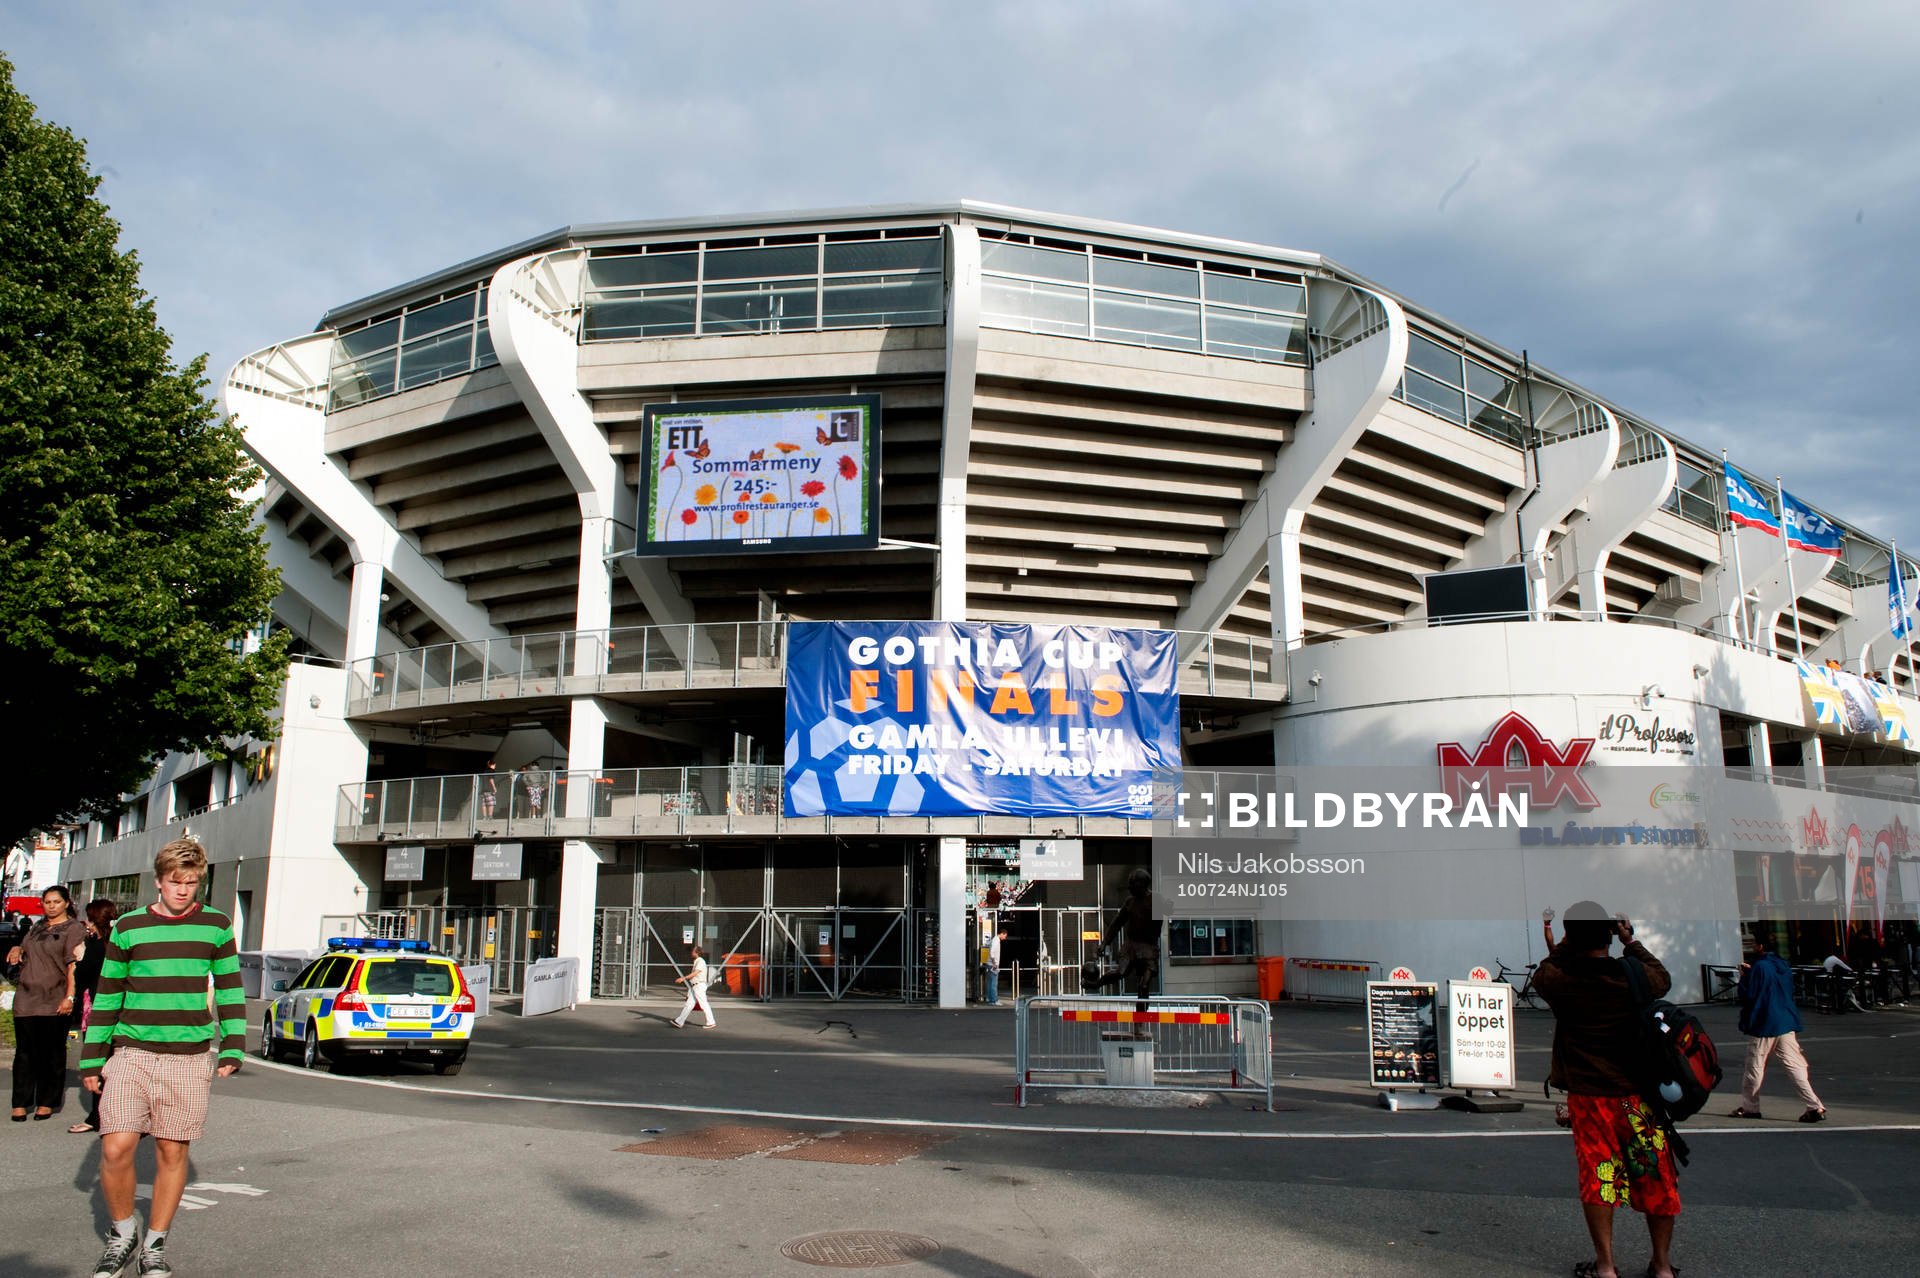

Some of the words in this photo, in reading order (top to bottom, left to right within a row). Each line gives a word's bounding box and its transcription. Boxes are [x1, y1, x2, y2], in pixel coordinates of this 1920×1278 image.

[668, 425, 703, 449] ETT
[692, 456, 822, 475] Sommarmeny
[734, 479, 778, 494] 245:-
[694, 500, 819, 513] www.profilrestauranger.se
[848, 636, 1022, 668] GOTHIA
[1043, 640, 1124, 670] CUP
[850, 669, 1125, 717] FINALS
[848, 723, 989, 750] GAMLA
[1001, 727, 1125, 753] ULLEVI
[1615, 714, 1696, 754] Professore
[848, 754, 948, 776] FRIDAY
[985, 755, 1125, 777] SATURDAY
[1437, 711, 1601, 808] MAX
[400, 847, 409, 859] 4
[492, 844, 502, 858] 4
[1046, 841, 1057, 857] 4
[1393, 969, 1409, 980] MAX
[1472, 968, 1487, 980] MAX
[1457, 992, 1472, 1008] Vi
[1478, 992, 1504, 1010] har
[1457, 1011, 1504, 1032] öppet
